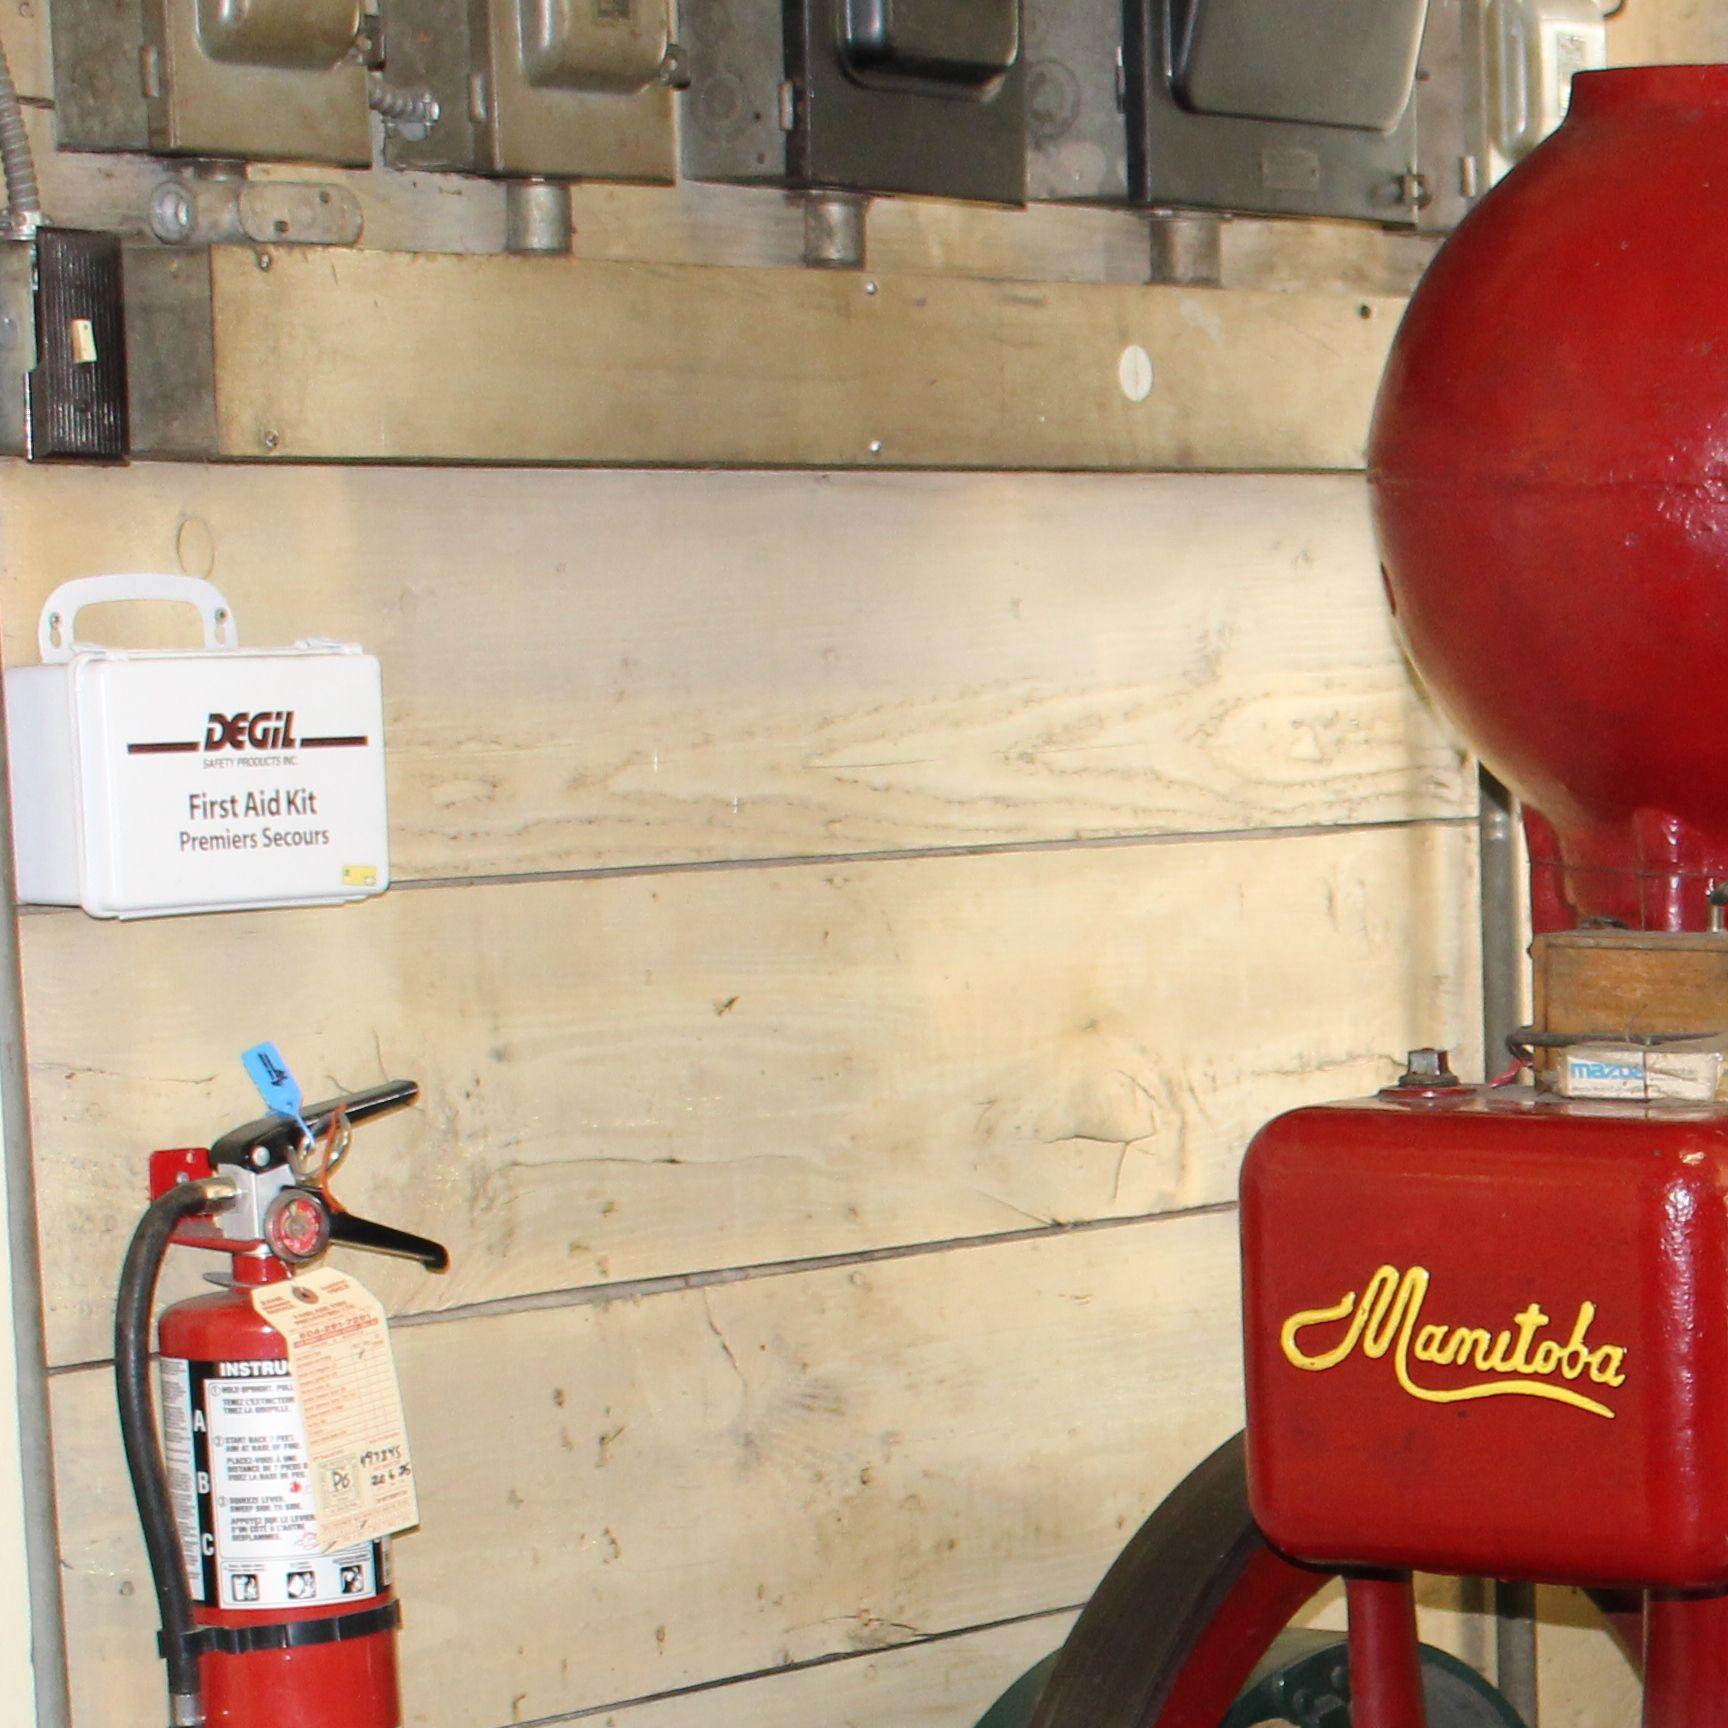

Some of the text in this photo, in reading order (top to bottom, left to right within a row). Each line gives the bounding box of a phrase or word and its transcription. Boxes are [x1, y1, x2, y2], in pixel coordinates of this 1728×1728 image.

[203, 757, 235, 769] SAFETY
[237, 756, 282, 768] PRODUCTS
[188, 788, 317, 820] First Aid Kit
[179, 827, 330, 852] Premiers Secours
[1280, 1264, 1627, 1419] Manitoba
[219, 1360, 290, 1377] INSTRU
[193, 1409, 207, 1432] A
[197, 1471, 210, 1494] B
[202, 1532, 214, 1556] C
